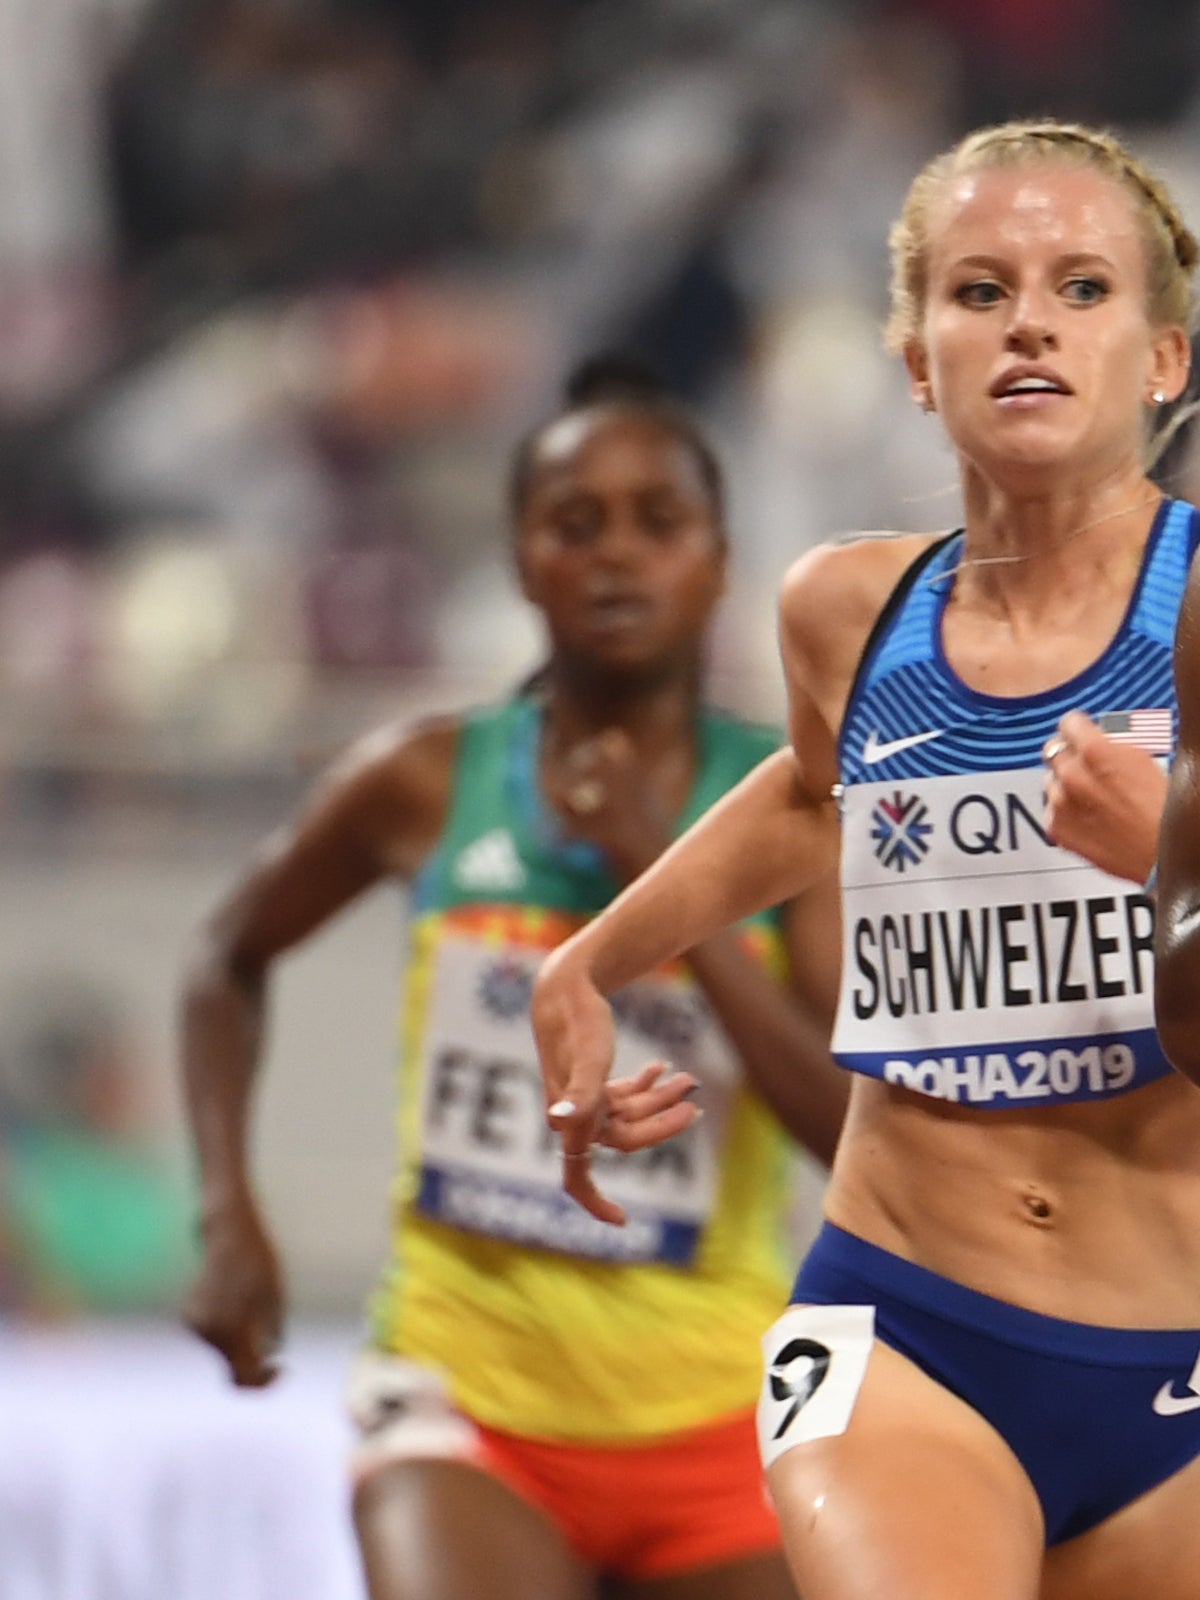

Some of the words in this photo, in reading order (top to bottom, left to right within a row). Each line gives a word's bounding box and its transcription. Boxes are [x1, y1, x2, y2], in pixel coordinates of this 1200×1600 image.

[949, 792, 1055, 856] QN
[854, 893, 1155, 1021] SCHWEIZER
[768, 1337, 832, 1440] 9
